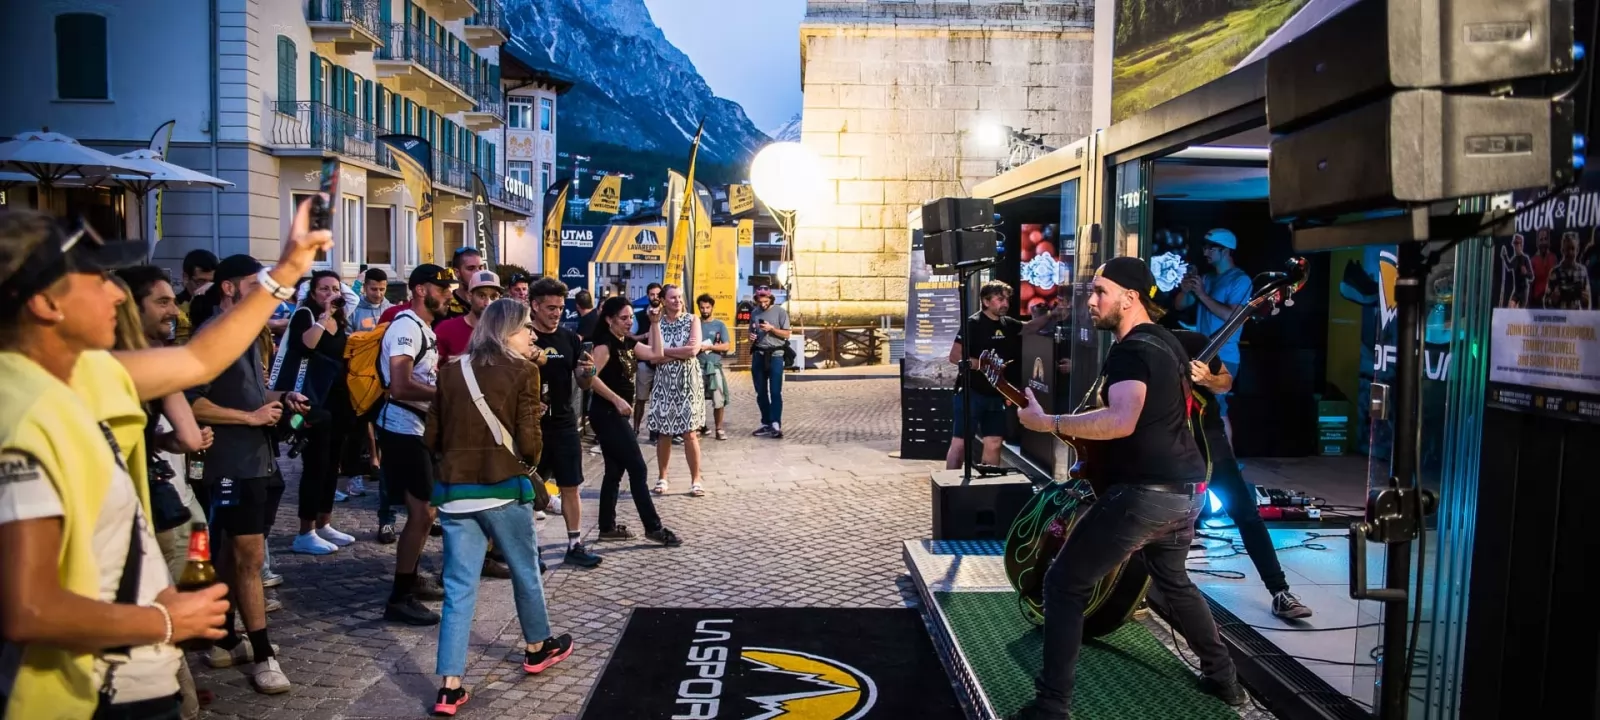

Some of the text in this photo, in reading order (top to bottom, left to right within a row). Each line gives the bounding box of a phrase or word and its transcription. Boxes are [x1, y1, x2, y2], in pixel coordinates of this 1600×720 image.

[504, 175, 534, 201] CORTINA
[1514, 191, 1600, 232] ROCK & RUN
[561, 229, 593, 240] UTMB
[671, 645, 729, 720] SPOR
